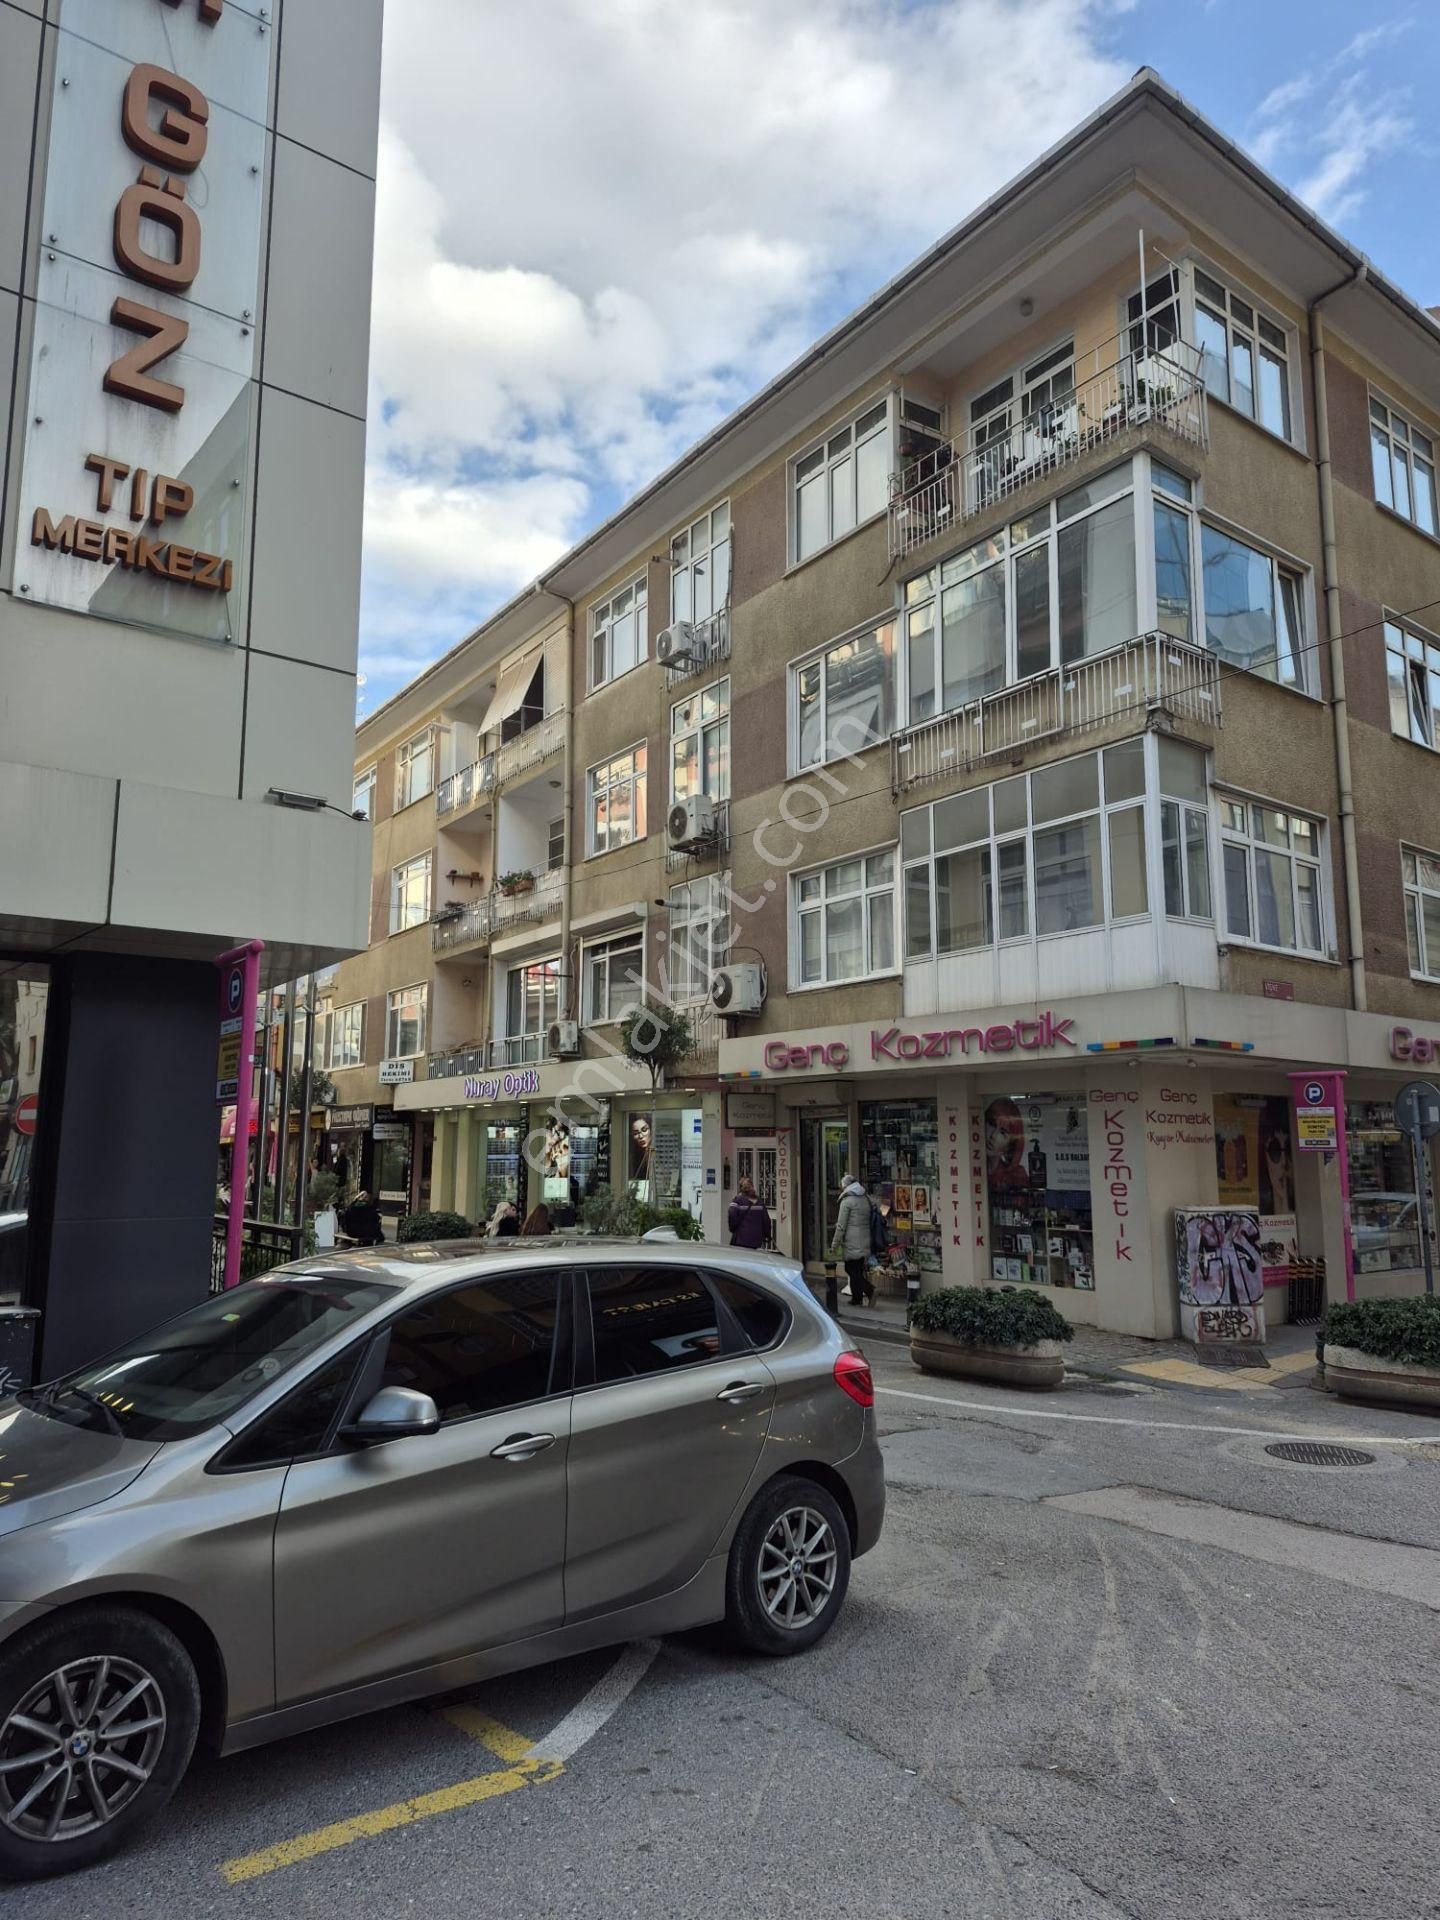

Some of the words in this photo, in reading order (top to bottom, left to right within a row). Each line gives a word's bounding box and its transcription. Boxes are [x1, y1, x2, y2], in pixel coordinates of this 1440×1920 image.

[84, 453, 194, 526] TIP
[764, 1041, 850, 1071] Genç
[869, 1010, 1077, 1062] Kozmetik
[464, 1076, 500, 1102] Nuray
[504, 1069, 540, 1099] Optik
[1088, 1089, 1140, 1104] Genç
[1159, 1088, 1199, 1104] Genç
[1145, 1109, 1212, 1126] Kozmetik
